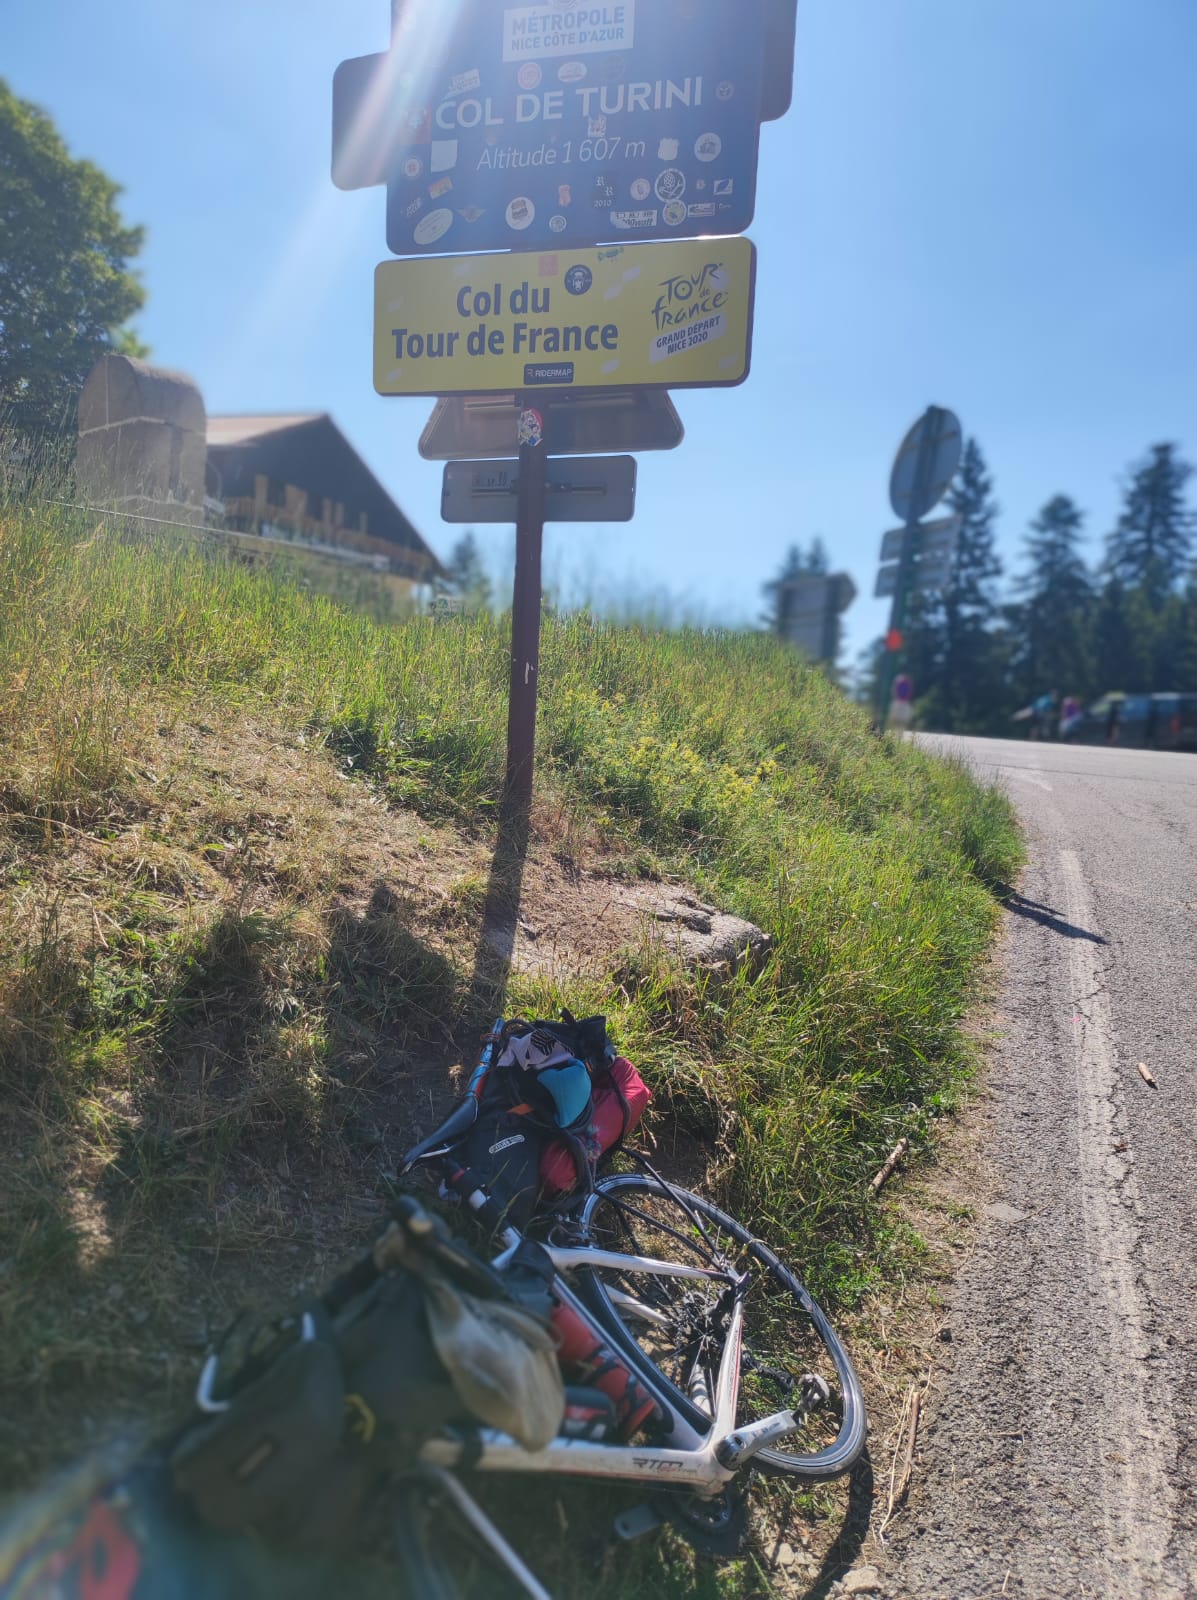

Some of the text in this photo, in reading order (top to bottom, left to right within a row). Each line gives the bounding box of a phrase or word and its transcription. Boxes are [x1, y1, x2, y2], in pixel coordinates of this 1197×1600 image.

[511, 6, 625, 36] MÉTROPOLE
[511, 27, 625, 51] NICE CÔTE D'AZUR
[435, 76, 703, 129] COL DE TURINI
[476, 143, 557, 171] Altitude
[624, 139, 646, 158] m
[456, 281, 550, 317] Col du
[391, 322, 619, 359] Tour de France
[656, 315, 721, 348] GRAND DÉPART
[667, 331, 709, 354] NICE 2020
